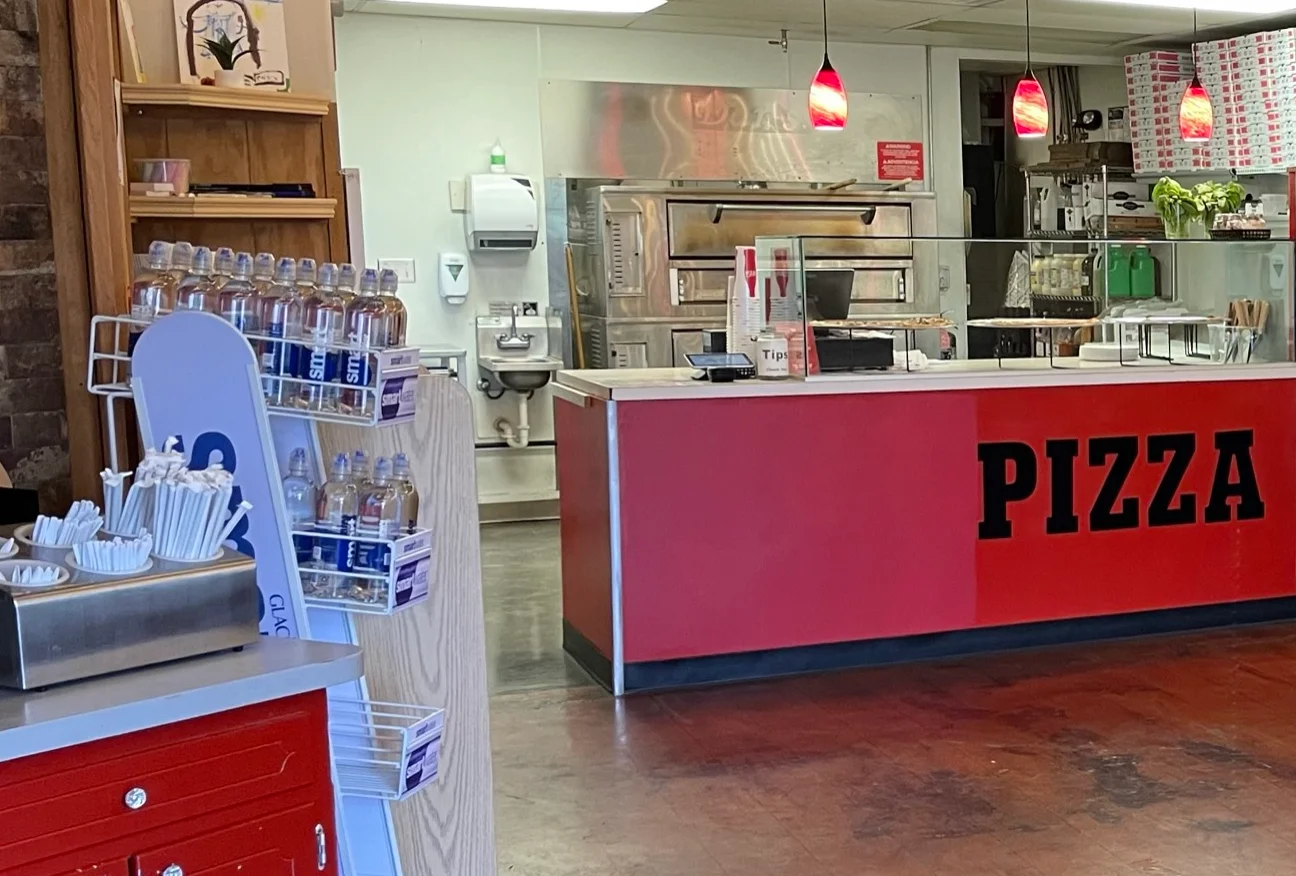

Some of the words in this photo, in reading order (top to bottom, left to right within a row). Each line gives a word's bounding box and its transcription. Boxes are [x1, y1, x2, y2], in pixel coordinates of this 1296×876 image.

[762, 349, 789, 362] Tips
[977, 429, 1265, 541] PIZZA
[269, 594, 291, 638] GLAC
